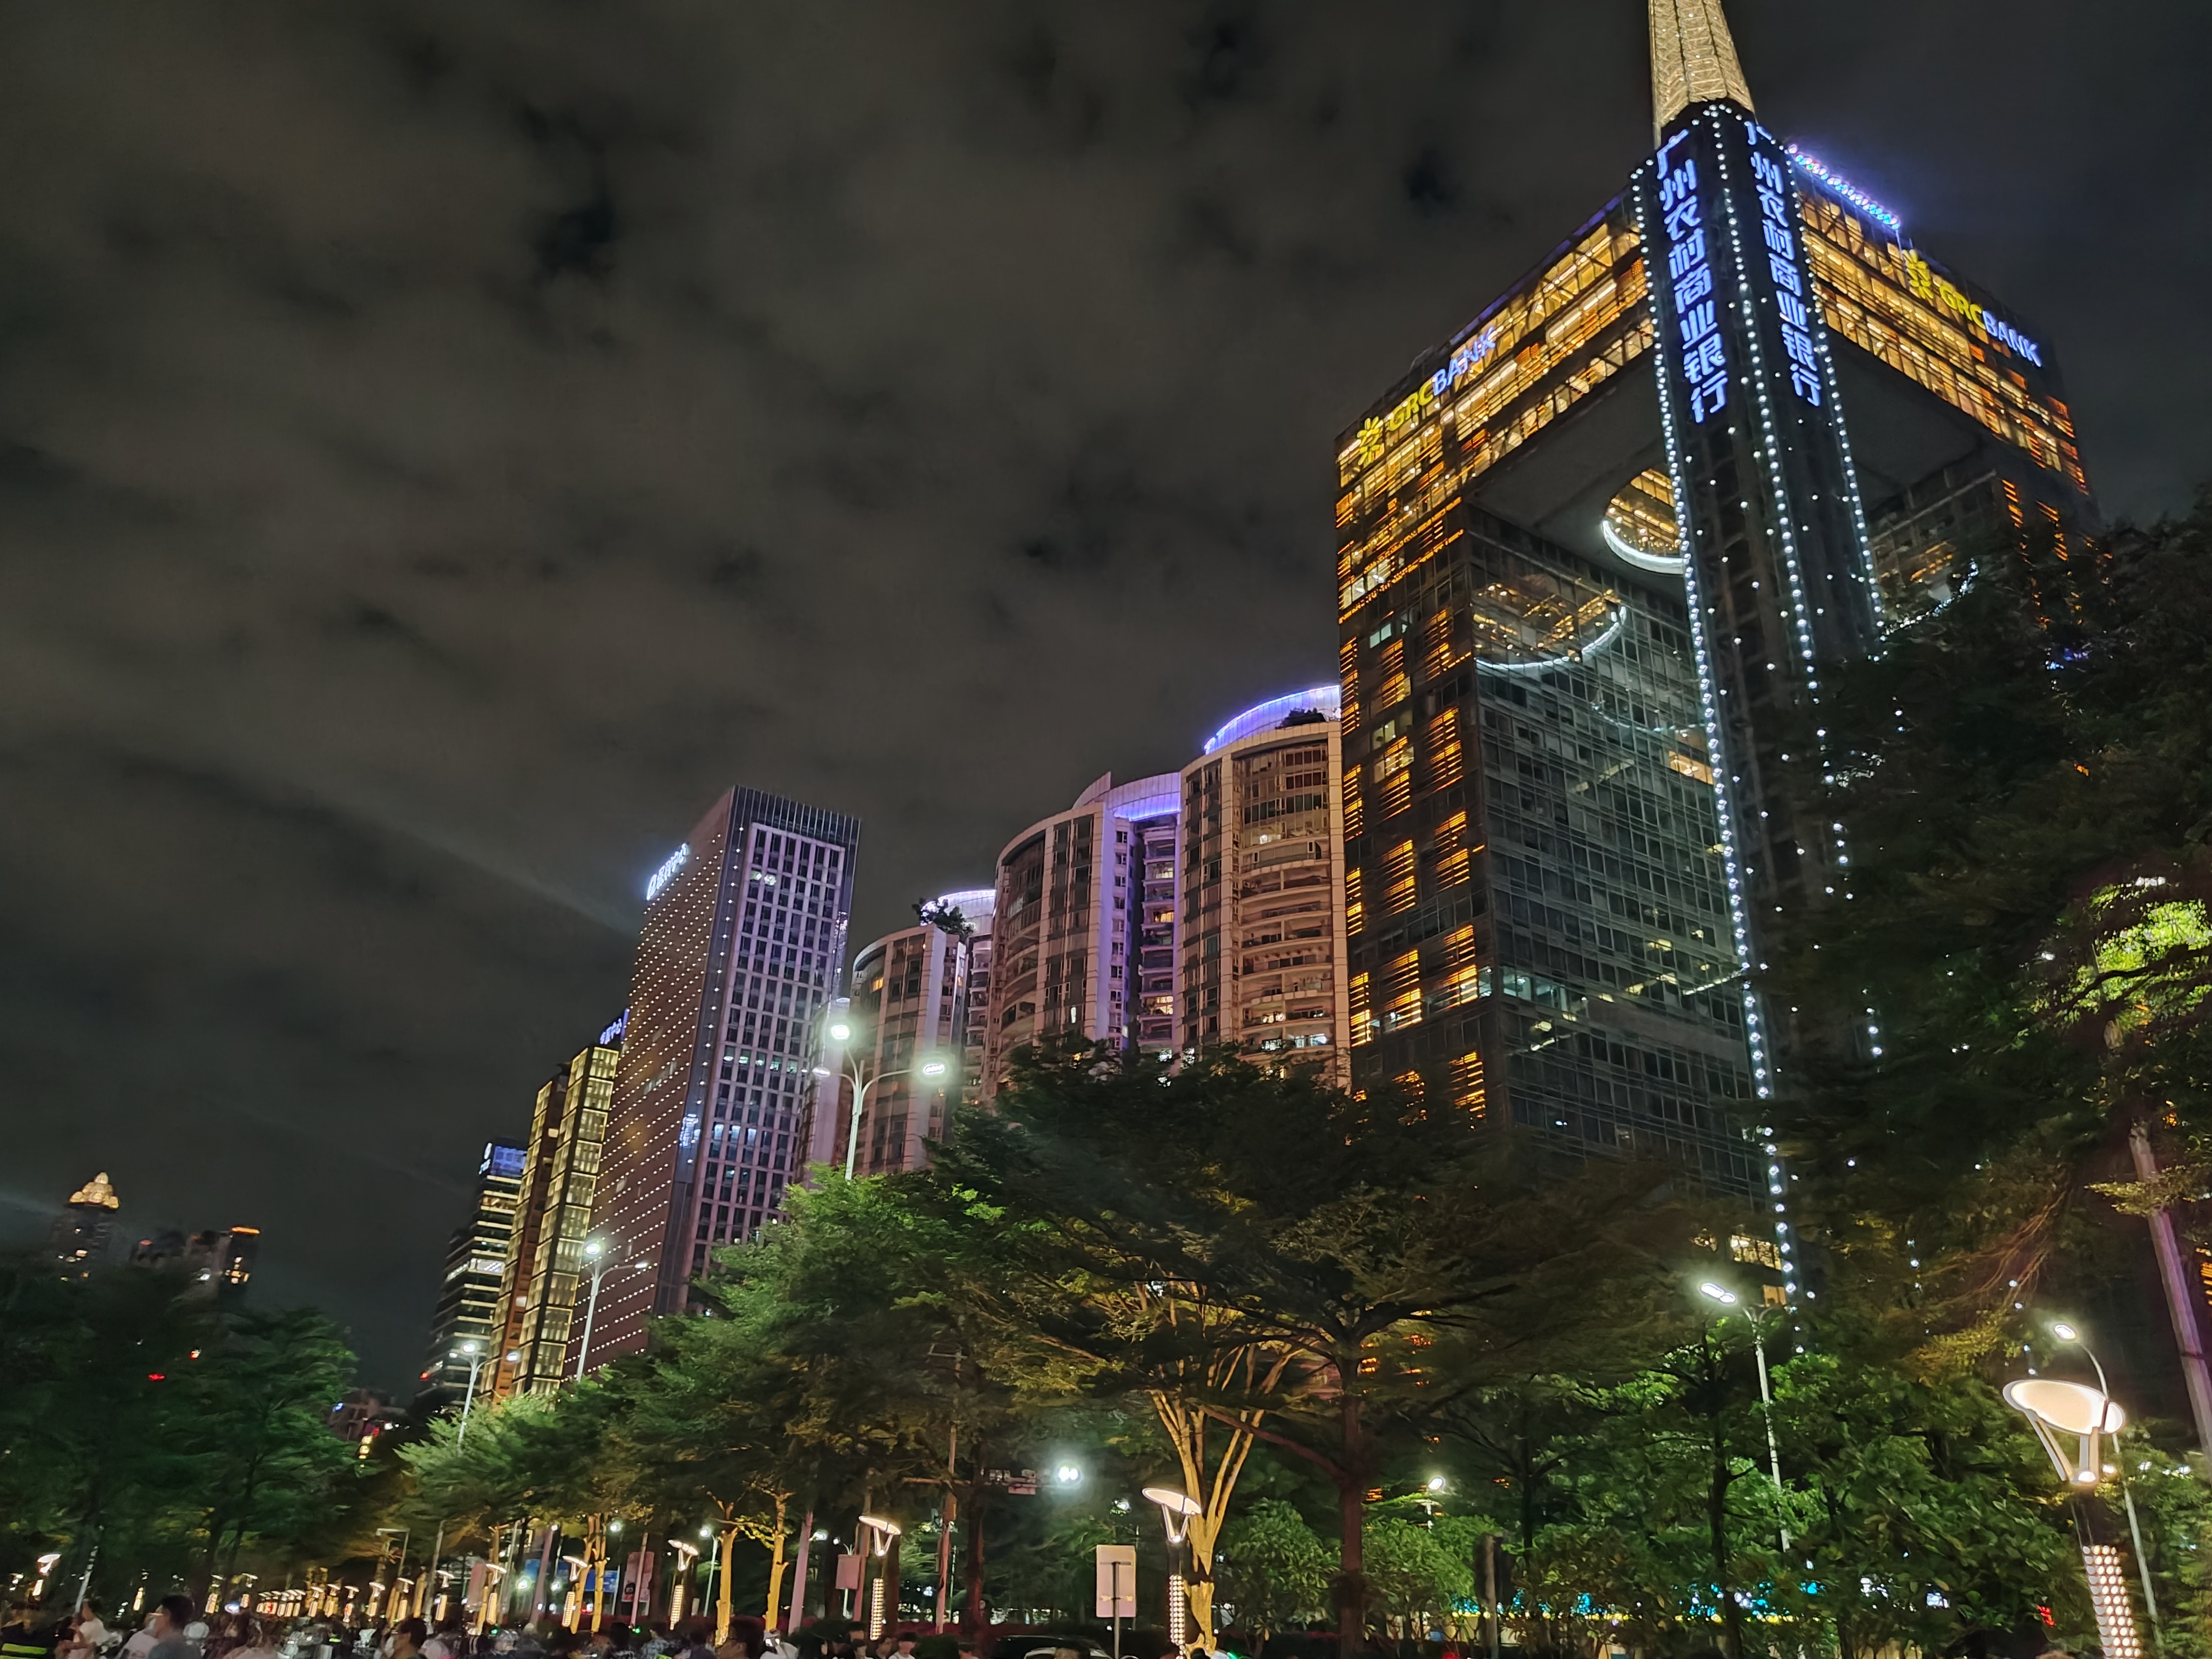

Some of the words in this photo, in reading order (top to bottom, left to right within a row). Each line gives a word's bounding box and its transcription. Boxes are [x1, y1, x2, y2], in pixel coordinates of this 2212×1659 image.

[1657, 129, 1728, 423] 广州农村商业银行
[1744, 122, 1820, 406] 广州农村商业银行
